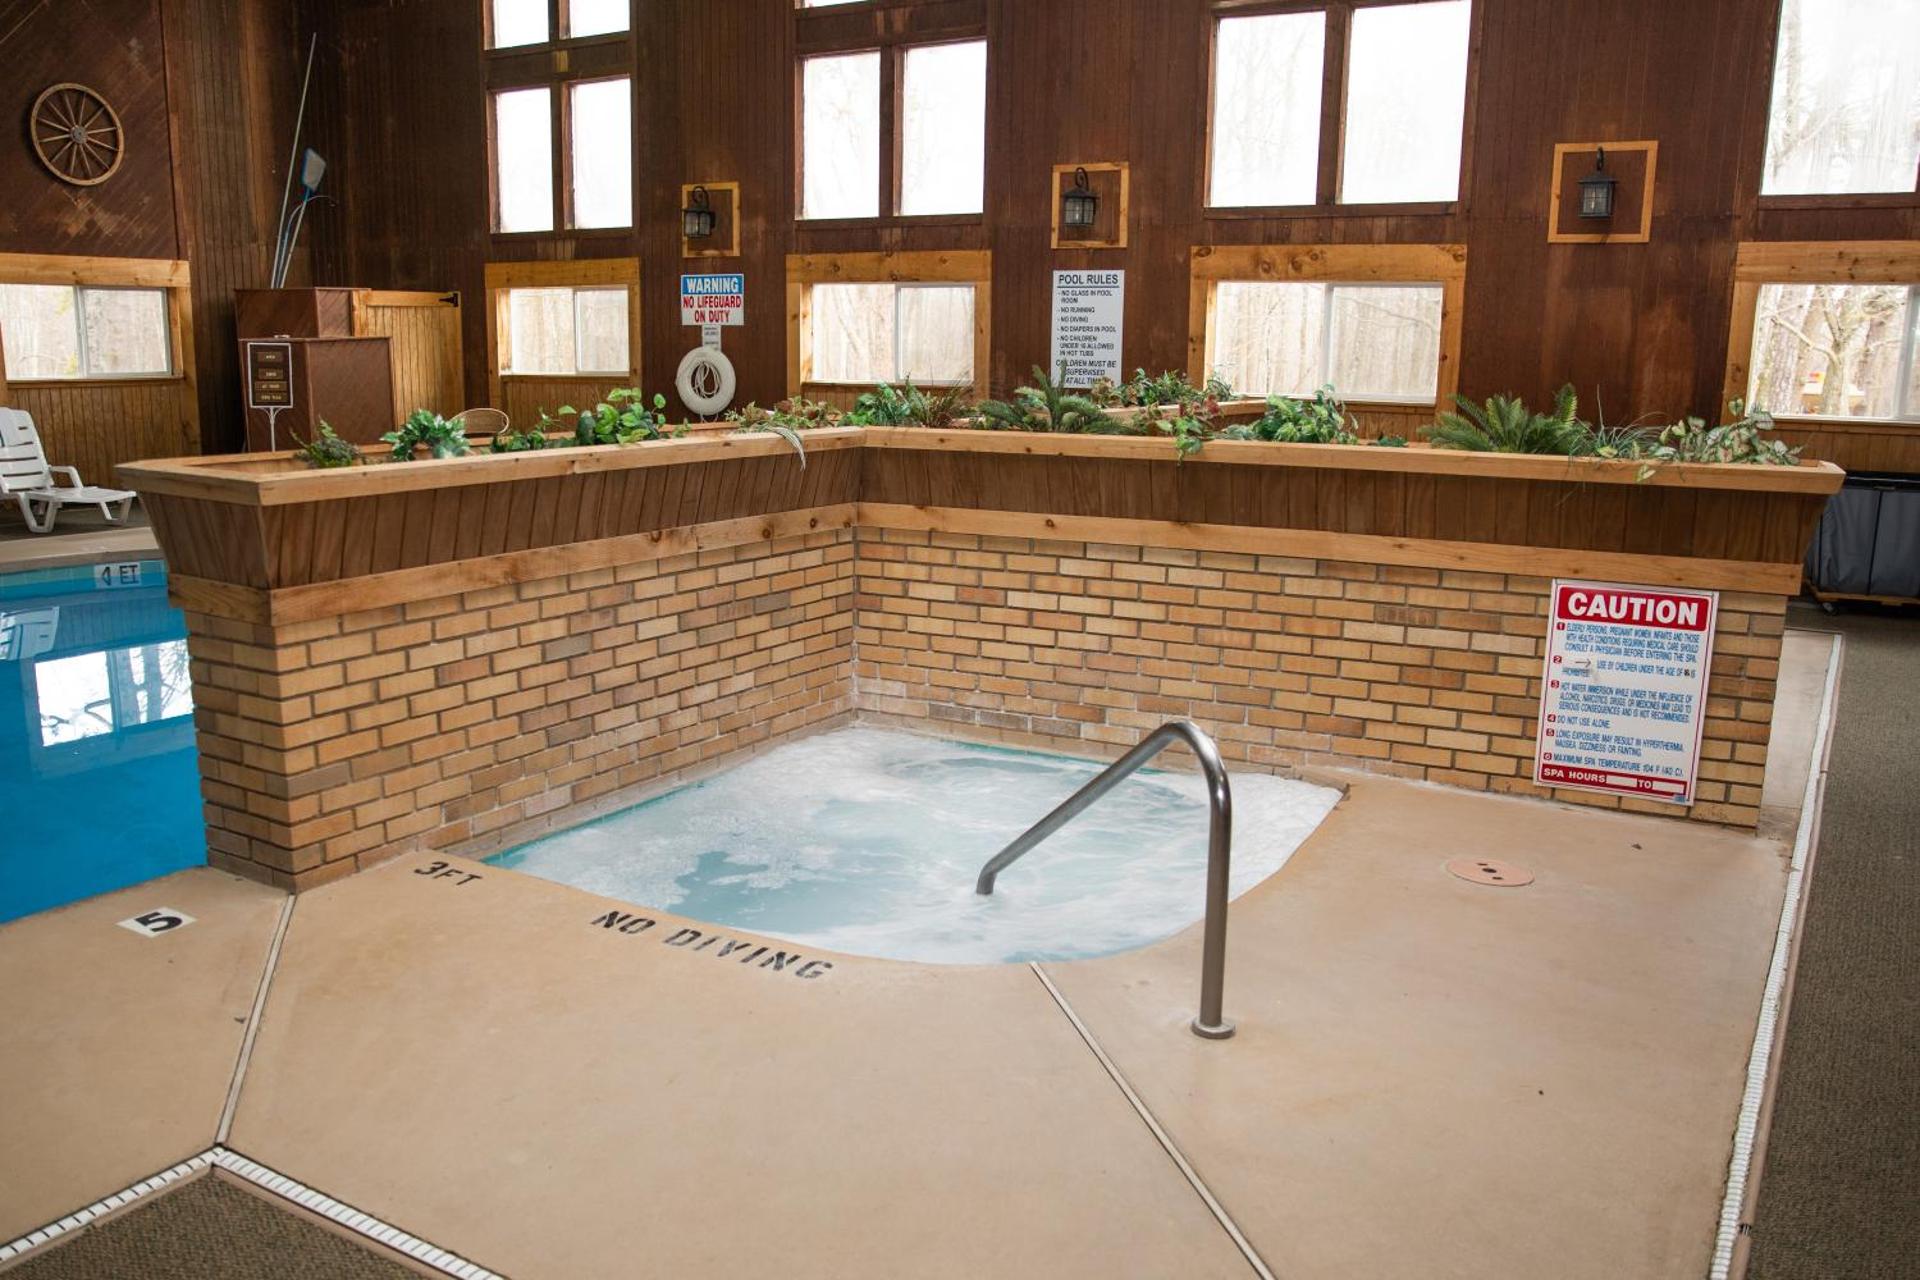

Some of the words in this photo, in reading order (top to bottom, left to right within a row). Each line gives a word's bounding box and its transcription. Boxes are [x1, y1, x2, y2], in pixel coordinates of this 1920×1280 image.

[687, 277, 738, 293] WARNING
[1059, 274, 1085, 285] POOL
[1086, 274, 1119, 285] RULES
[683, 296, 695, 308] NO
[697, 295, 742, 308] LIFEGUARD
[694, 310, 706, 323] ON
[709, 310, 731, 323] DUTY
[1567, 592, 1699, 626] CAUTION
[1567, 623, 1585, 632] ELDERLY
[1609, 627, 1632, 637] PREGNANT
[1653, 631, 1672, 641] INFANTS
[1672, 633, 1683, 642] AND
[1684, 634, 1699, 643] THOSE
[1564, 642, 1588, 652] CONSULT
[1595, 645, 1622, 655] PHYSICIAN
[1623, 648, 1645, 658] BEFORE
[1646, 650, 1672, 661] ENTERING
[1673, 653, 1685, 662] THE
[1578, 633, 1594, 643] HEALTH
[1595, 635, 1620, 645] CONDITIONS
[1622, 638, 1646, 648] REQUIRING
[1647, 640, 1666, 650] MEDICAL
[1666, 642, 1679, 651] CARE
[1680, 643, 1698, 653] SHOULD
[1597, 660, 1606, 668] USE
[1615, 661, 1637, 672] CHILDREN
[1638, 664, 1654, 674] UNDER
[1655, 666, 1665, 675] THE
[1666, 667, 1675, 676] AGE
[1561, 681, 1569, 690] HOT
[1571, 682, 1586, 692] WATER
[1587, 684, 1614, 695] IMMERSION
[1615, 687, 1629, 697] WHILE
[1630, 689, 1646, 699] UNDER
[1648, 691, 1657, 700] THE
[1658, 692, 1685, 703] INFLUENCE
[1559, 700, 1580, 711] SERIOUS
[1581, 702, 1621, 716] CONSEQUENCES
[1622, 707, 1632, 716] AND
[1639, 709, 1650, 718] NOT
[1635, 699, 1661, 710] MEDICINES
[1661, 702, 1670, 711] MAY
[1671, 703, 1684, 713] LEAD
[1557, 714, 1565, 723] DO
[1566, 715, 1578, 725] NOT
[1579, 717, 1589, 726] USE
[1556, 728, 1571, 738] LONG
[1572, 730, 1600, 742] EXPOSURE
[1601, 733, 1613, 743] MAY
[1613, 735, 1634, 746] RESULT
[1579, 740, 1606, 752] DIZZINESS
[1608, 744, 1616, 753] OR
[1553, 752, 1582, 764] MAXIMUM
[1584, 756, 1595, 765] SPA
[1598, 757, 1640, 771] TEMPERATURE
[1642, 763, 1654, 772] 104
[1544, 768, 1564, 778] SPA
[1568, 771, 1605, 783] HOURS
[1638, 779, 1652, 789] TO
[414, 861, 482, 886] 3FT
[135, 912, 183, 933] 5
[591, 910, 656, 934] NO
[662, 928, 833, 979] DIVING
